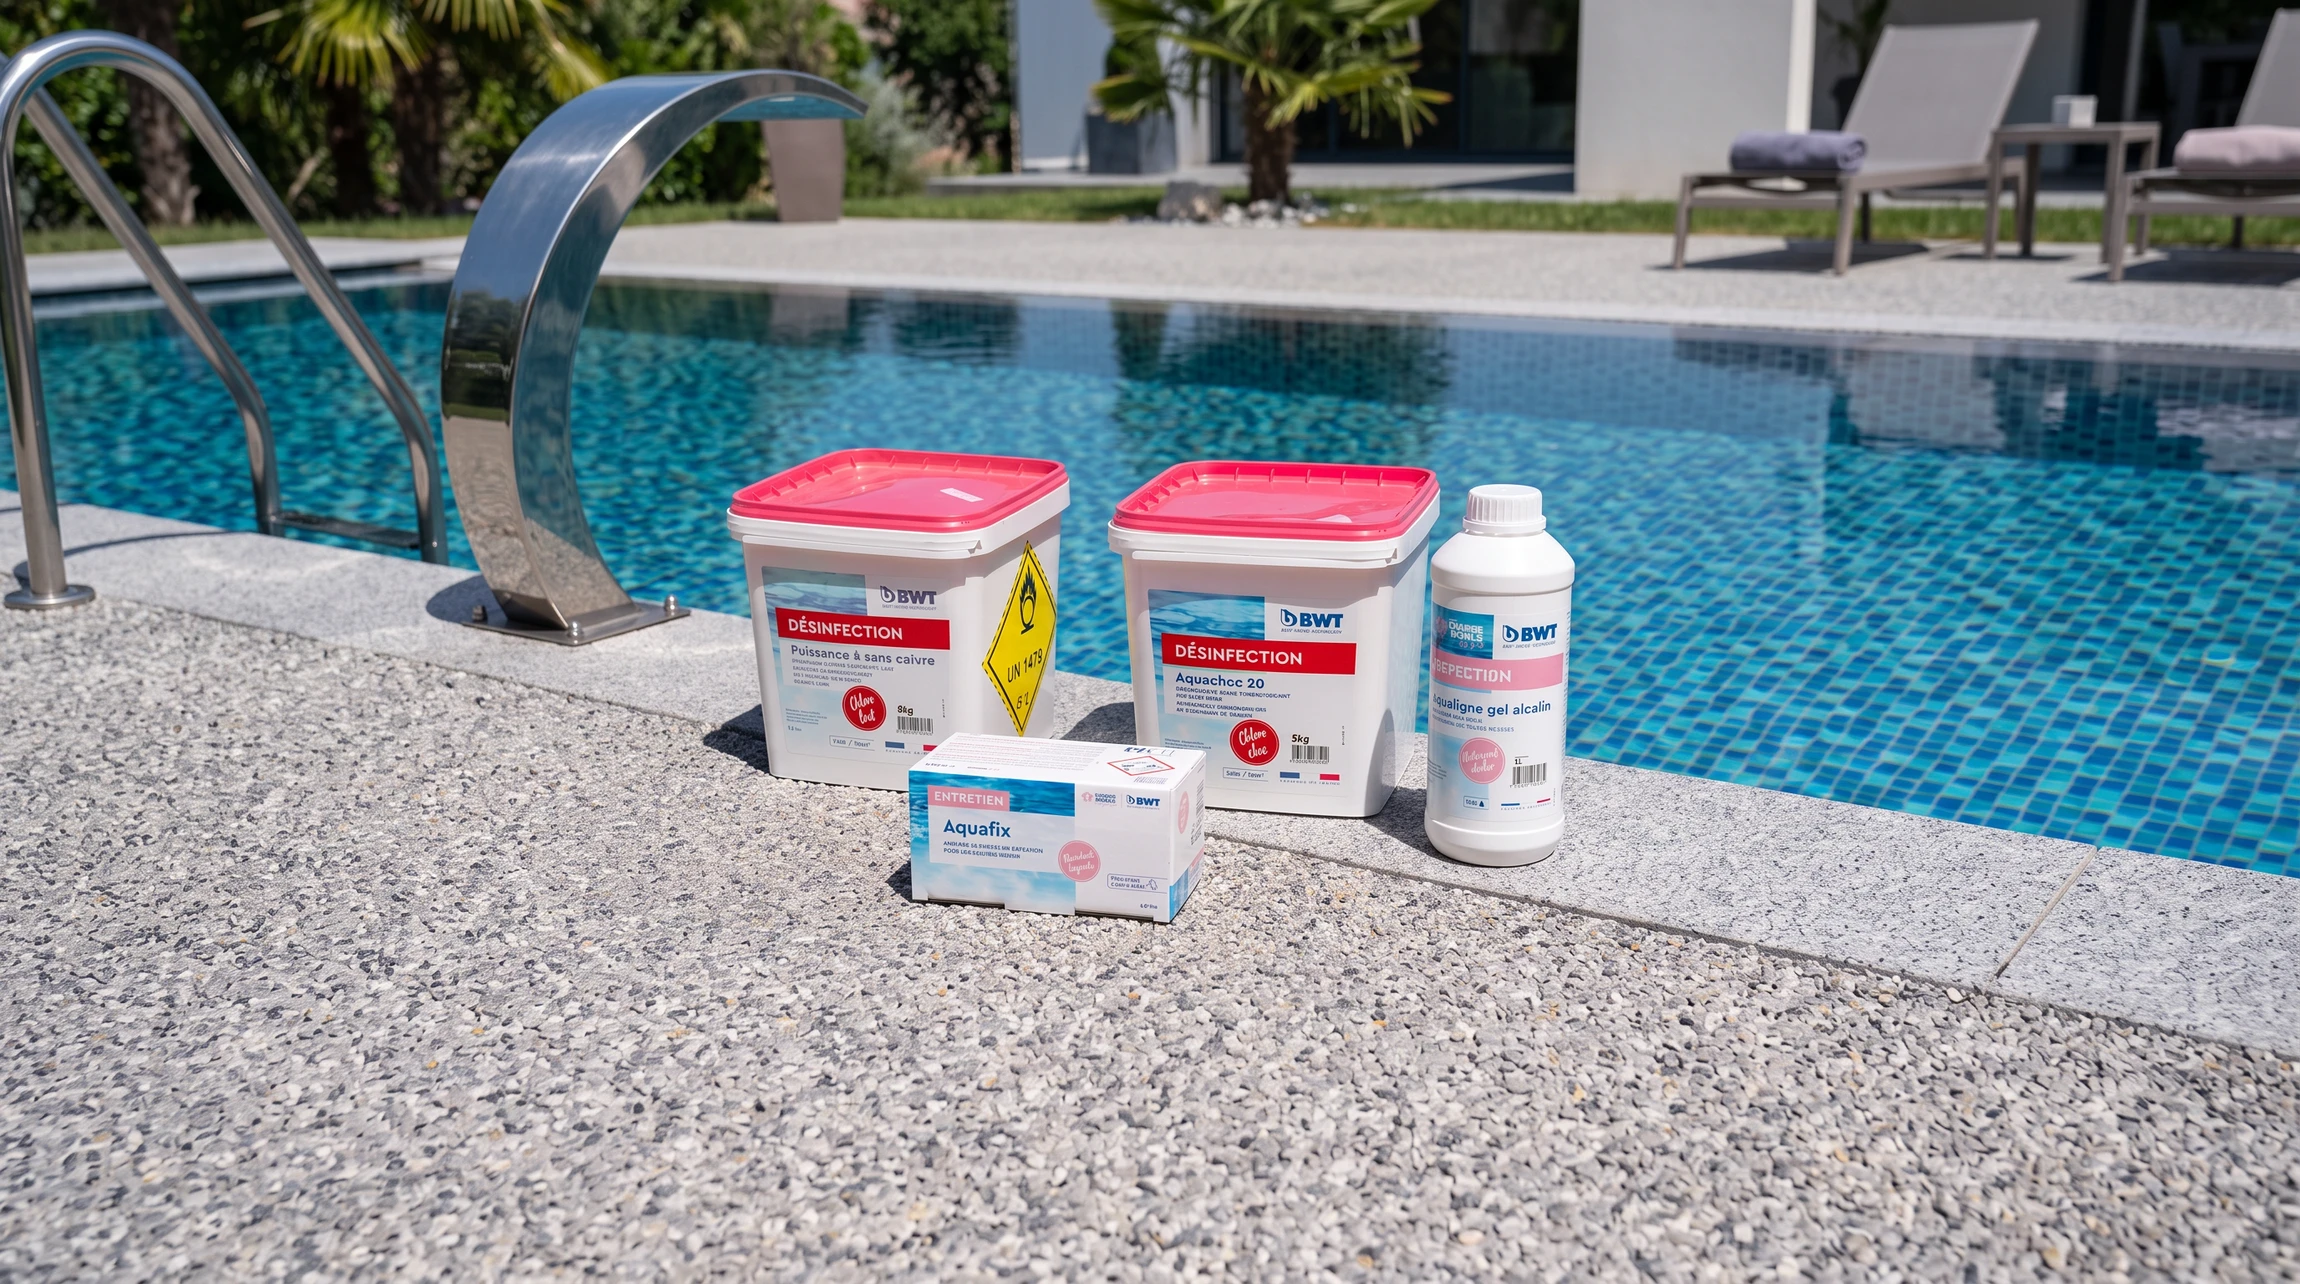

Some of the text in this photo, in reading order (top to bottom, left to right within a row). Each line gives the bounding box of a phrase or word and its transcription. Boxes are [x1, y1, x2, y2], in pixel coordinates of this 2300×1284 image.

[897, 589, 937, 605] BWT
[788, 615, 903, 640] DÉSINFECTION
[1299, 612, 1344, 628] BWT
[1520, 622, 1558, 642] BWT
[791, 644, 849, 660] Puissance
[864, 653, 892, 664] sans
[895, 654, 936, 666] caivre
[1175, 641, 1303, 666] DÉSINFECTION
[1007, 648, 1043, 683] UN 1479
[1247, 678, 1265, 689] 20
[1487, 703, 1509, 717] gel
[1512, 700, 1551, 715] alcalin
[1291, 734, 1310, 745] 5kg
[934, 791, 1004, 806] ENTRETIEN
[1136, 797, 1161, 806] BWT
[943, 819, 1011, 838] Aquafix
